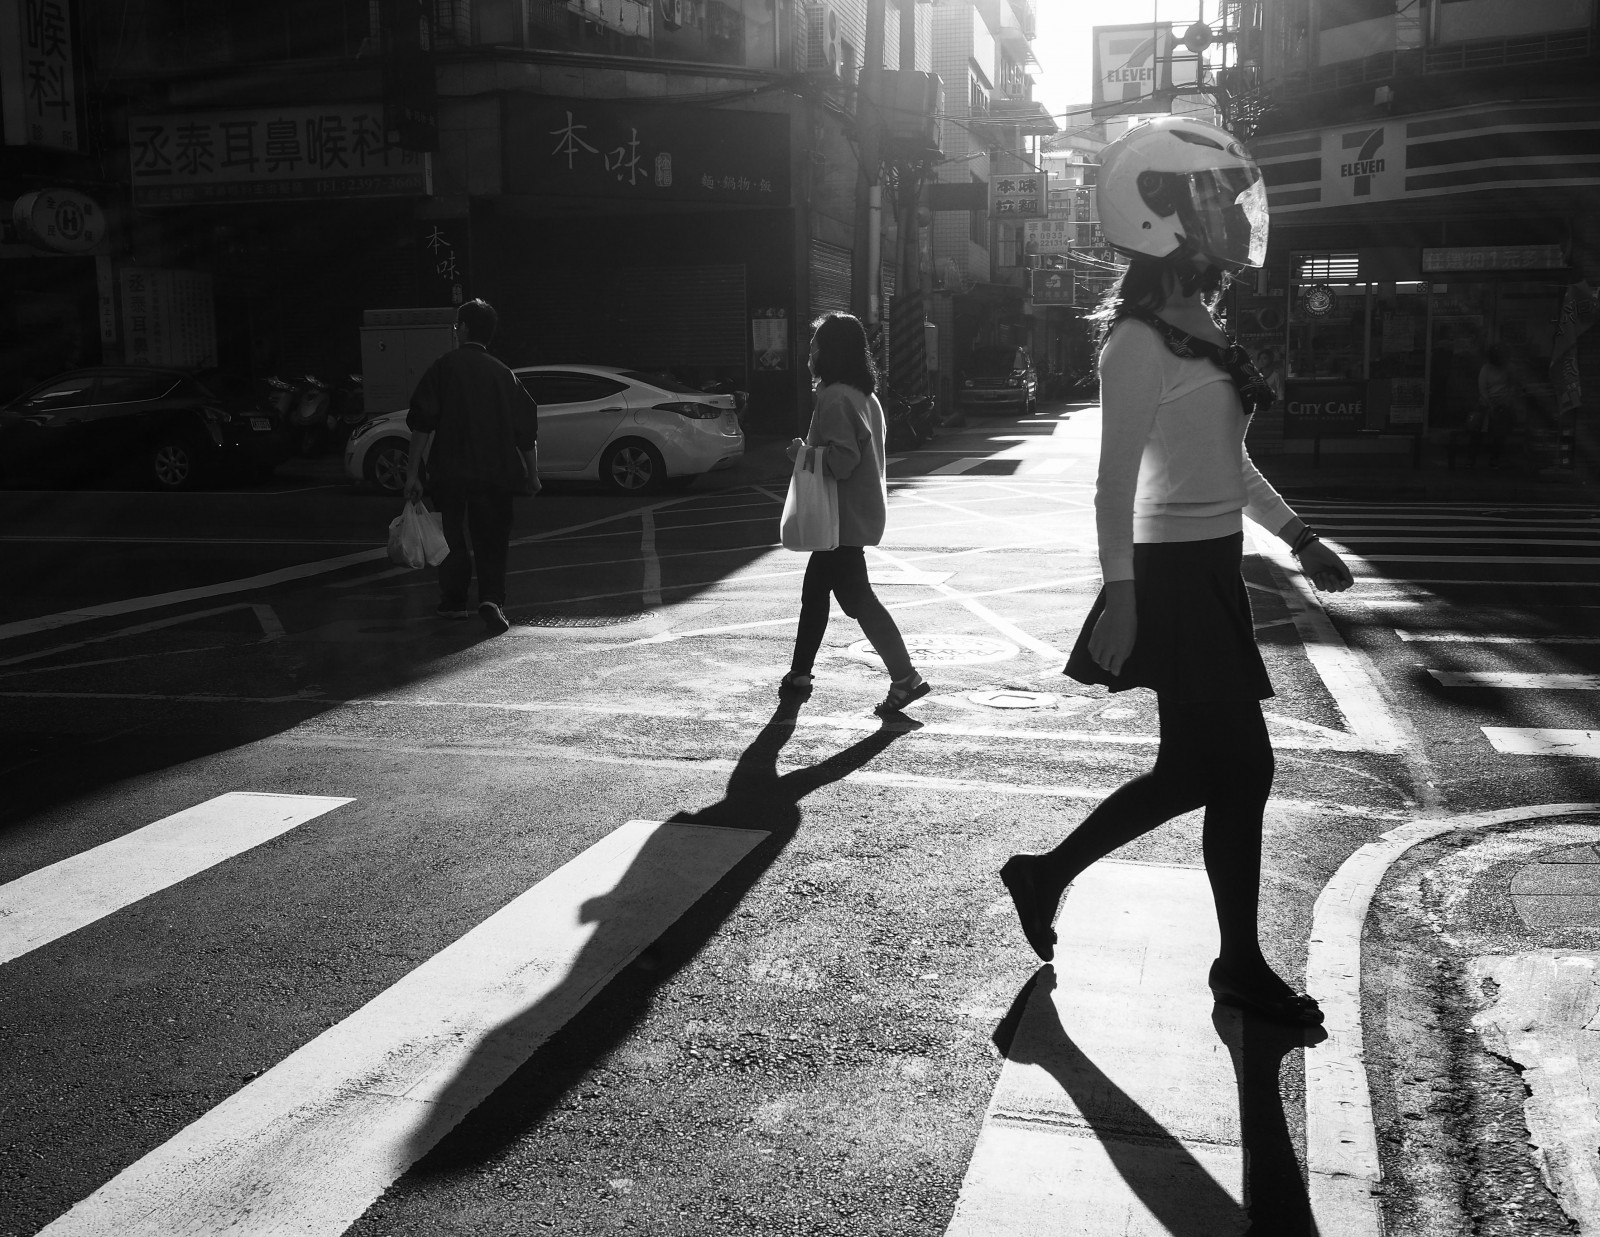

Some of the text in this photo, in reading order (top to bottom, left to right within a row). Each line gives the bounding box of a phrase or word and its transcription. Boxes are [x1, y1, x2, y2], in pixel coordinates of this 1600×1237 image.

[548, 110, 649, 186] 本味
[997, 178, 1037, 194] 本味
[425, 225, 460, 280] 本味
[1287, 400, 1363, 415] CITY CAFÉ
